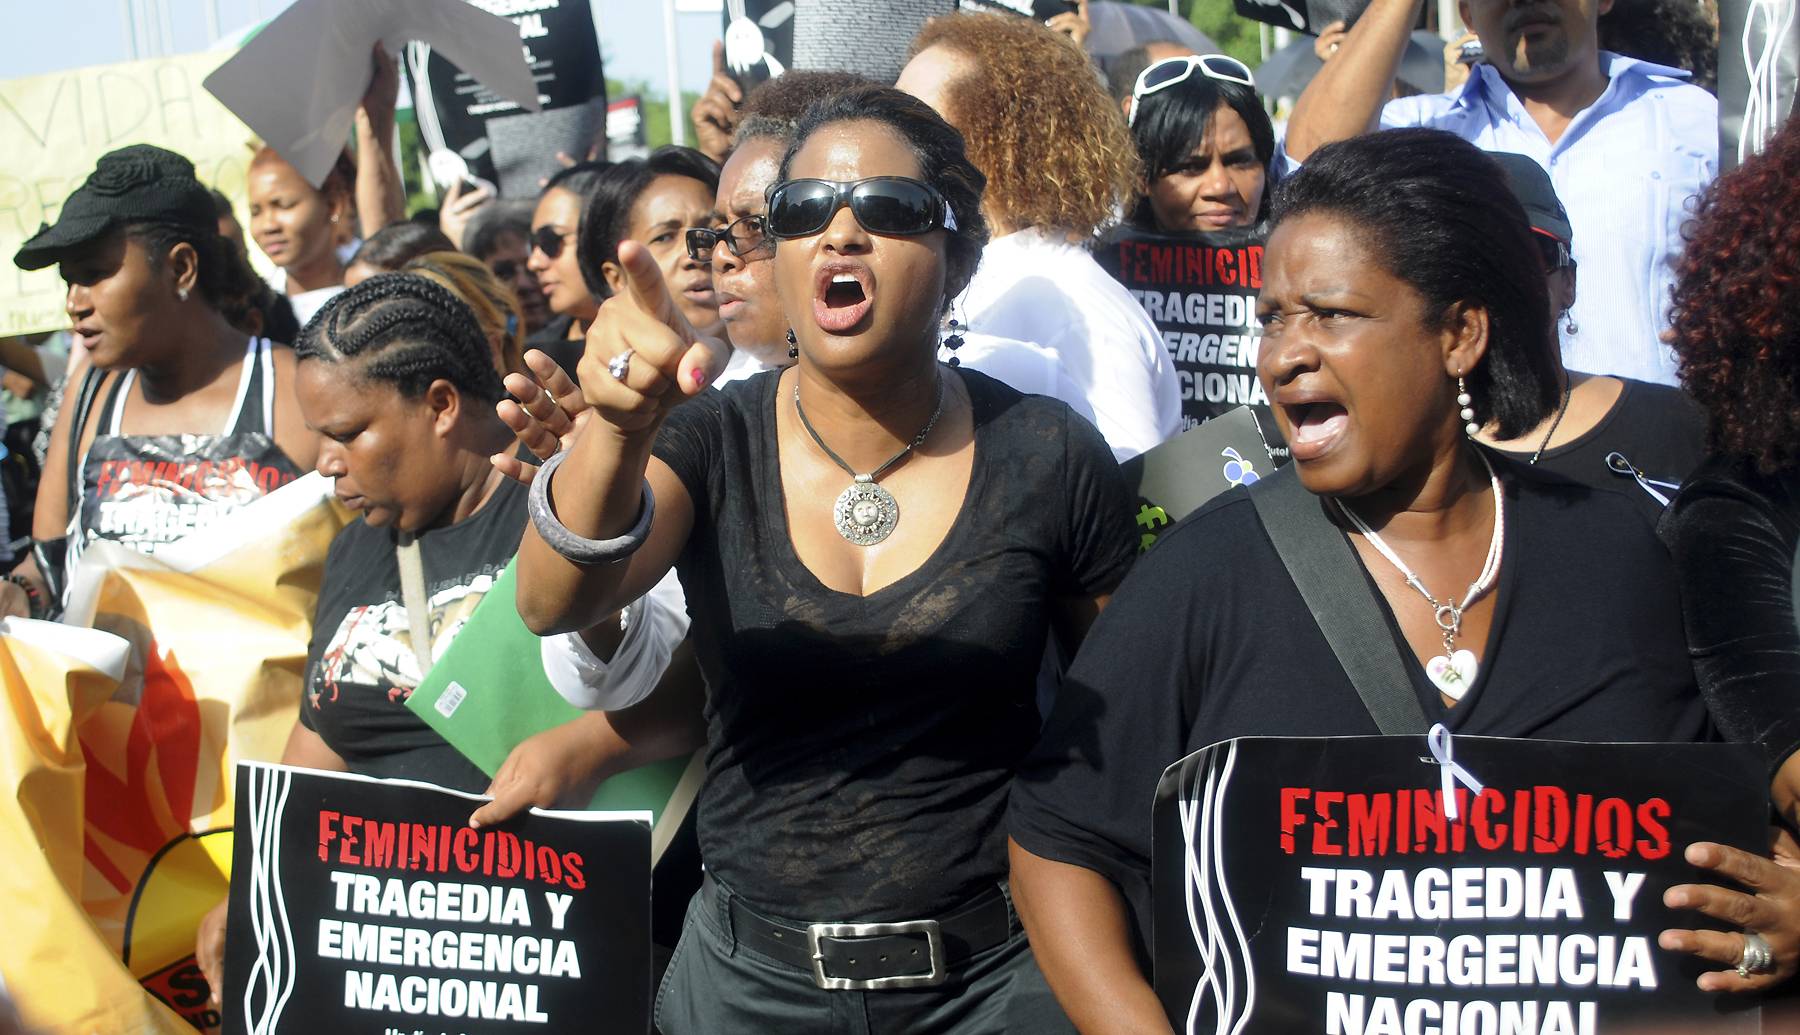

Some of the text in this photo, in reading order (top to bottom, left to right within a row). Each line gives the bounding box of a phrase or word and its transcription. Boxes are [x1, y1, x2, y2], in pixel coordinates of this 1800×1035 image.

[0, 62, 202, 148] VIDA
[1119, 239, 1265, 289] FEMINICID
[1127, 289, 1263, 328] TRAGEDI
[1180, 371, 1270, 406] CIONA
[318, 810, 587, 890] FEMINICIDIOS
[1279, 785, 1672, 860] FEMINICIDIOS
[330, 870, 574, 930] TRAGEDIA Y
[1301, 866, 1646, 920] TRAGEDIA Y
[317, 918, 582, 979] EMERGENCIA
[1286, 926, 1658, 988] EMERGENCIA
[344, 970, 549, 1024] NACIONAL
